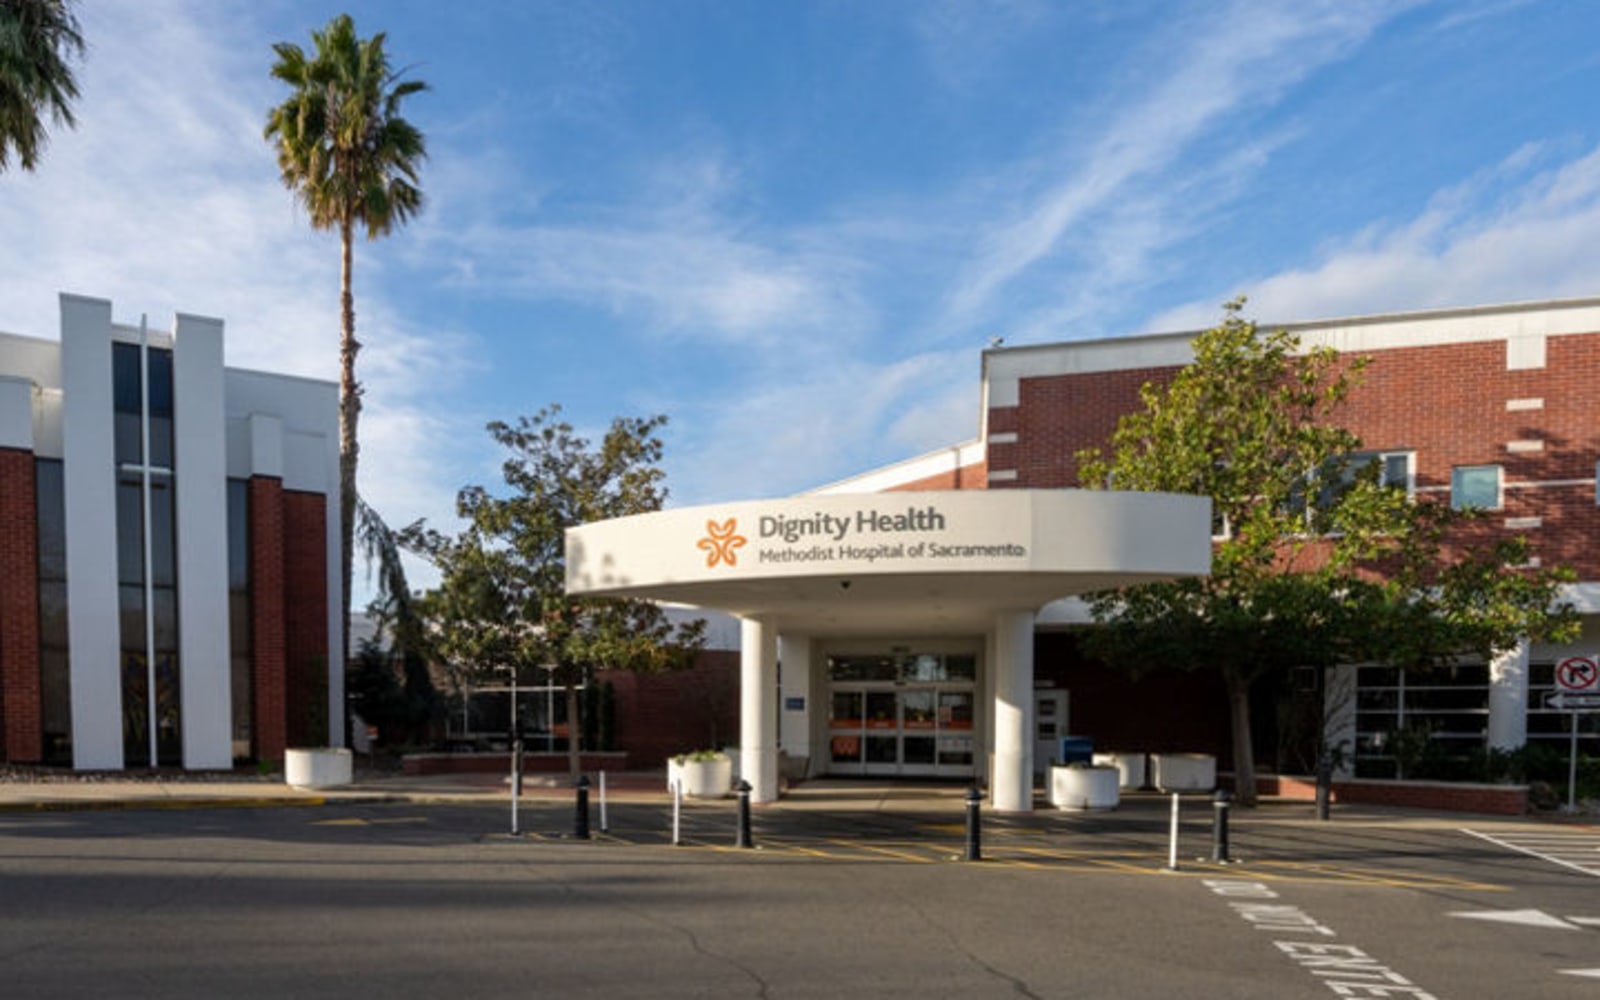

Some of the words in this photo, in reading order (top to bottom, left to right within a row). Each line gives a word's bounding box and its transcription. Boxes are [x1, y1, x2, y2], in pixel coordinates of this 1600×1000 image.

[759, 513, 850, 543] Dignity
[856, 507, 946, 533] Health
[759, 546, 835, 563] Methodist
[839, 544, 903, 563] Hospital
[907, 543, 925, 558] of
[928, 543, 1026, 558] Sacramento
[1273, 941, 1440, 1000] ENTE
